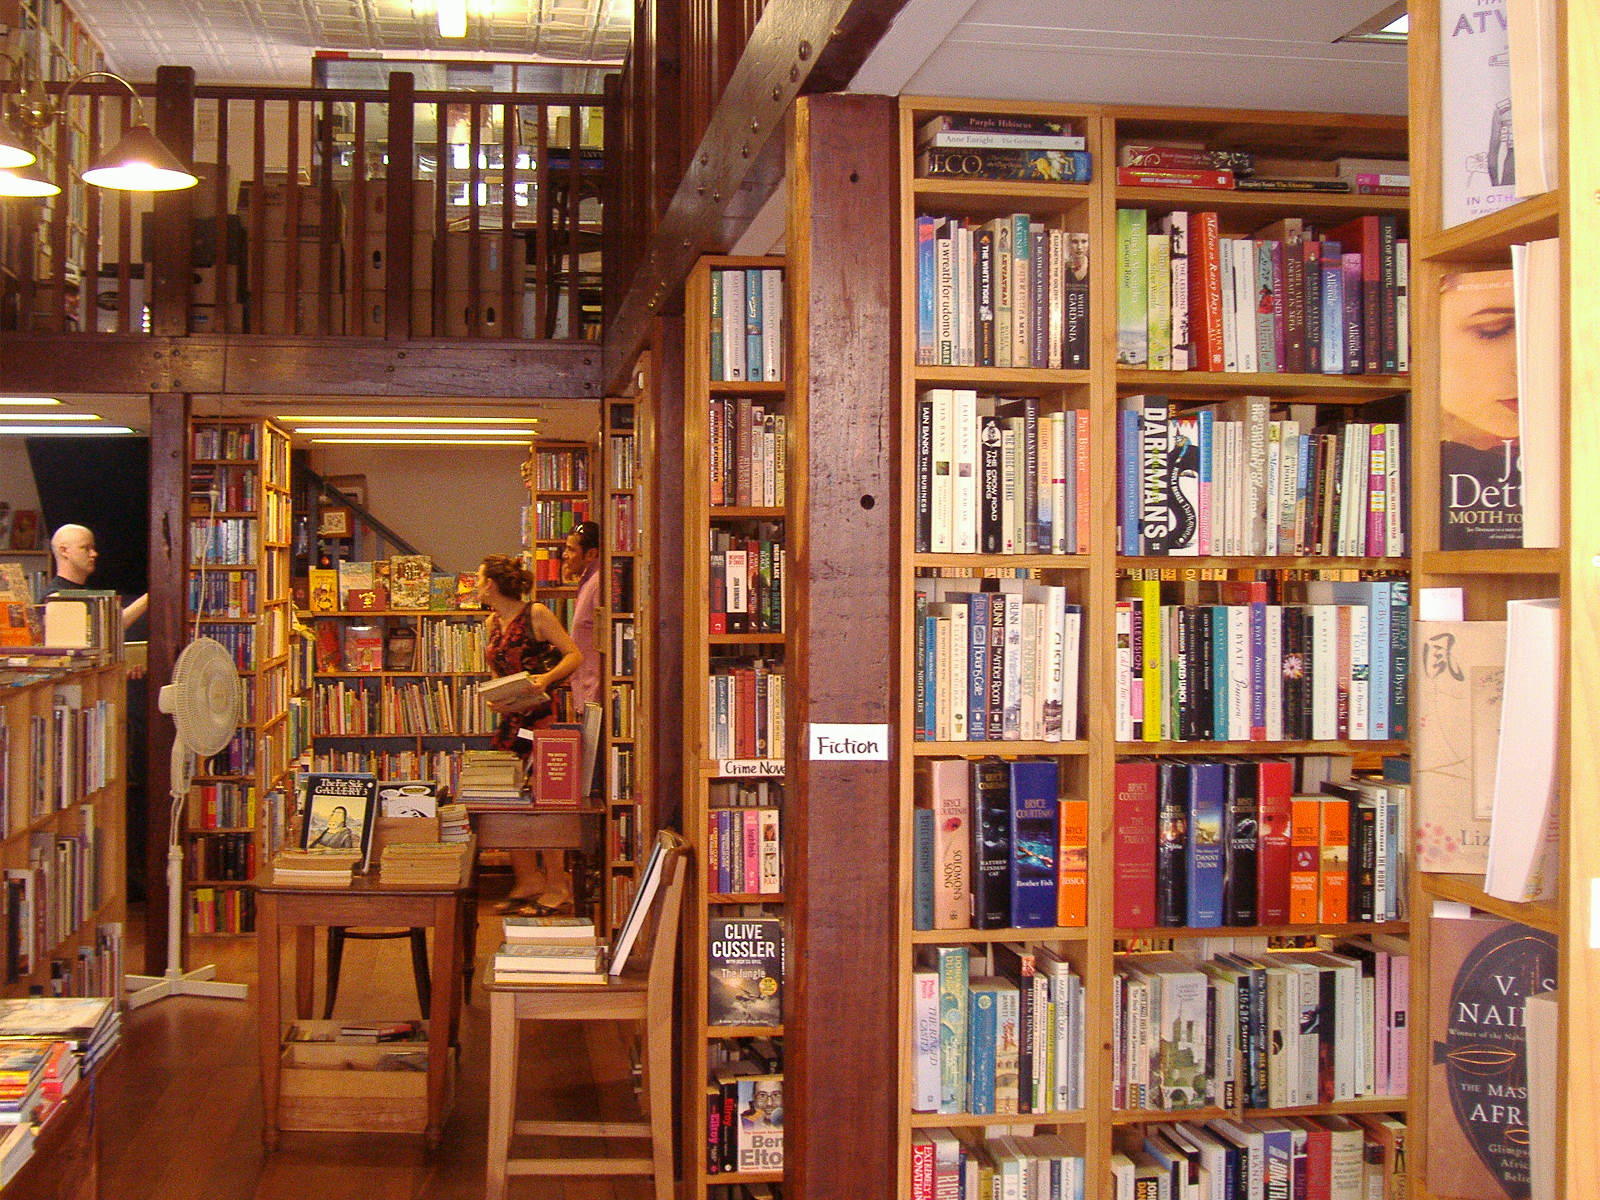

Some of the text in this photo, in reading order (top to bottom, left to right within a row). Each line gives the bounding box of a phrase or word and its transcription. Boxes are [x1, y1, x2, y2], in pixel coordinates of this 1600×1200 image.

[969, 118, 1032, 128] Purple Hibiscus
[946, 135, 965, 143] Anne
[967, 136, 994, 145] Enright
[1467, 196, 1480, 206] IN
[1016, 220, 1024, 256] AKUNIN
[942, 250, 951, 282] wreath
[982, 246, 990, 304] THE WHITE TIGER
[1207, 217, 1220, 315] Madras Rainy Days
[1385, 256, 1392, 267] MY
[942, 285, 951, 298] for
[1123, 270, 1131, 289] Rose
[1327, 272, 1337, 306] Allende
[942, 300, 952, 337] udomo
[1069, 293, 1077, 342] GARDENIA
[942, 341, 951, 364] FABER
[1349, 322, 1359, 356] Allende
[922, 407, 930, 424] IAIN
[922, 426, 930, 455] BANKS
[1006, 435, 1014, 446] THE
[1027, 406, 1036, 475] JOHN BANVILLE
[1079, 417, 1089, 473] Pat Barker
[1249, 425, 1259, 468] chivalry
[1144, 407, 1168, 539] DARKMANS
[1448, 510, 1523, 524] MOTH TO
[976, 602, 985, 624] BUNN
[1009, 602, 1019, 625] BUNN
[1375, 591, 1387, 643] Liz Byrski
[992, 603, 1003, 705] BUNN Amber Room
[1134, 611, 1142, 670] SELLEVISION
[1235, 634, 1243, 667] BYATT
[1178, 654, 1187, 703] NAKED LUNCH
[1254, 656, 1262, 683] ANGELS
[1393, 657, 1405, 705] Liz Byrski
[1254, 692, 1262, 720] INSECTS
[1338, 692, 1348, 720] Byrski
[1356, 695, 1364, 716] Byrski
[816, 736, 879, 756] Fiction
[725, 761, 757, 775] Crime
[314, 786, 362, 796] GALLERY
[319, 779, 334, 787] The
[336, 779, 348, 787] Far
[1024, 799, 1046, 808] BRYCE
[944, 863, 953, 889] SONG
[953, 850, 962, 900] SOLOMON'S
[1377, 871, 1385, 892] HOURS
[724, 924, 764, 940] CLIVE
[712, 941, 776, 958] CUSSLER
[721, 969, 767, 981] The Jungle
[1494, 975, 1519, 997] V.
[919, 1019, 928, 1056] CASTLE
[928, 1007, 938, 1066] THE RINGED
[1462, 1083, 1481, 1093] THE
[723, 1098, 734, 1126] Ellroy
[709, 1113, 720, 1144] Ellroy
[914, 1147, 924, 1200] JONATHAN
[924, 1147, 933, 1194] EXTREMELY
[1147, 1181, 1157, 1200] JOH
